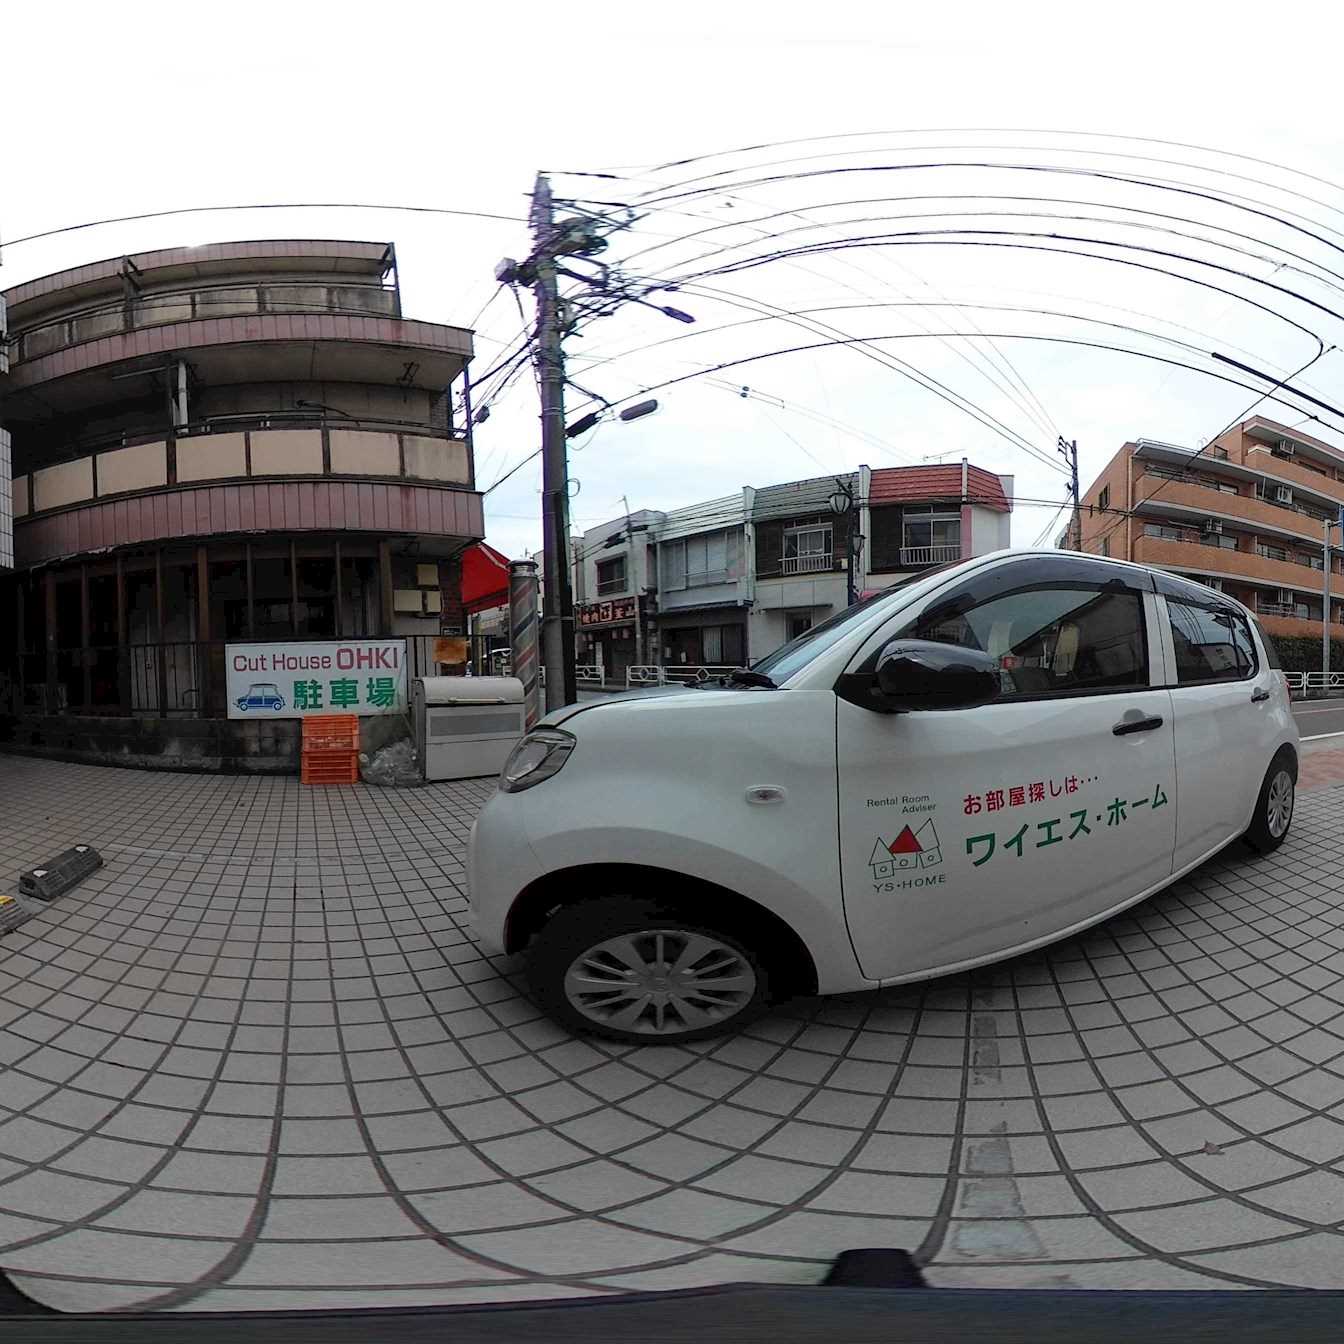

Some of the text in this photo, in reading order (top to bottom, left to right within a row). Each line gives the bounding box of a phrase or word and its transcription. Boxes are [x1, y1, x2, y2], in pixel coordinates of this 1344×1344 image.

[233, 647, 398, 672] Cut House OHKI
[292, 677, 396, 710] 駐車場
[867, 793, 930, 808] Rental Room
[901, 803, 937, 815] Adviser
[966, 784, 1169, 867] ワイエス・ホーム
